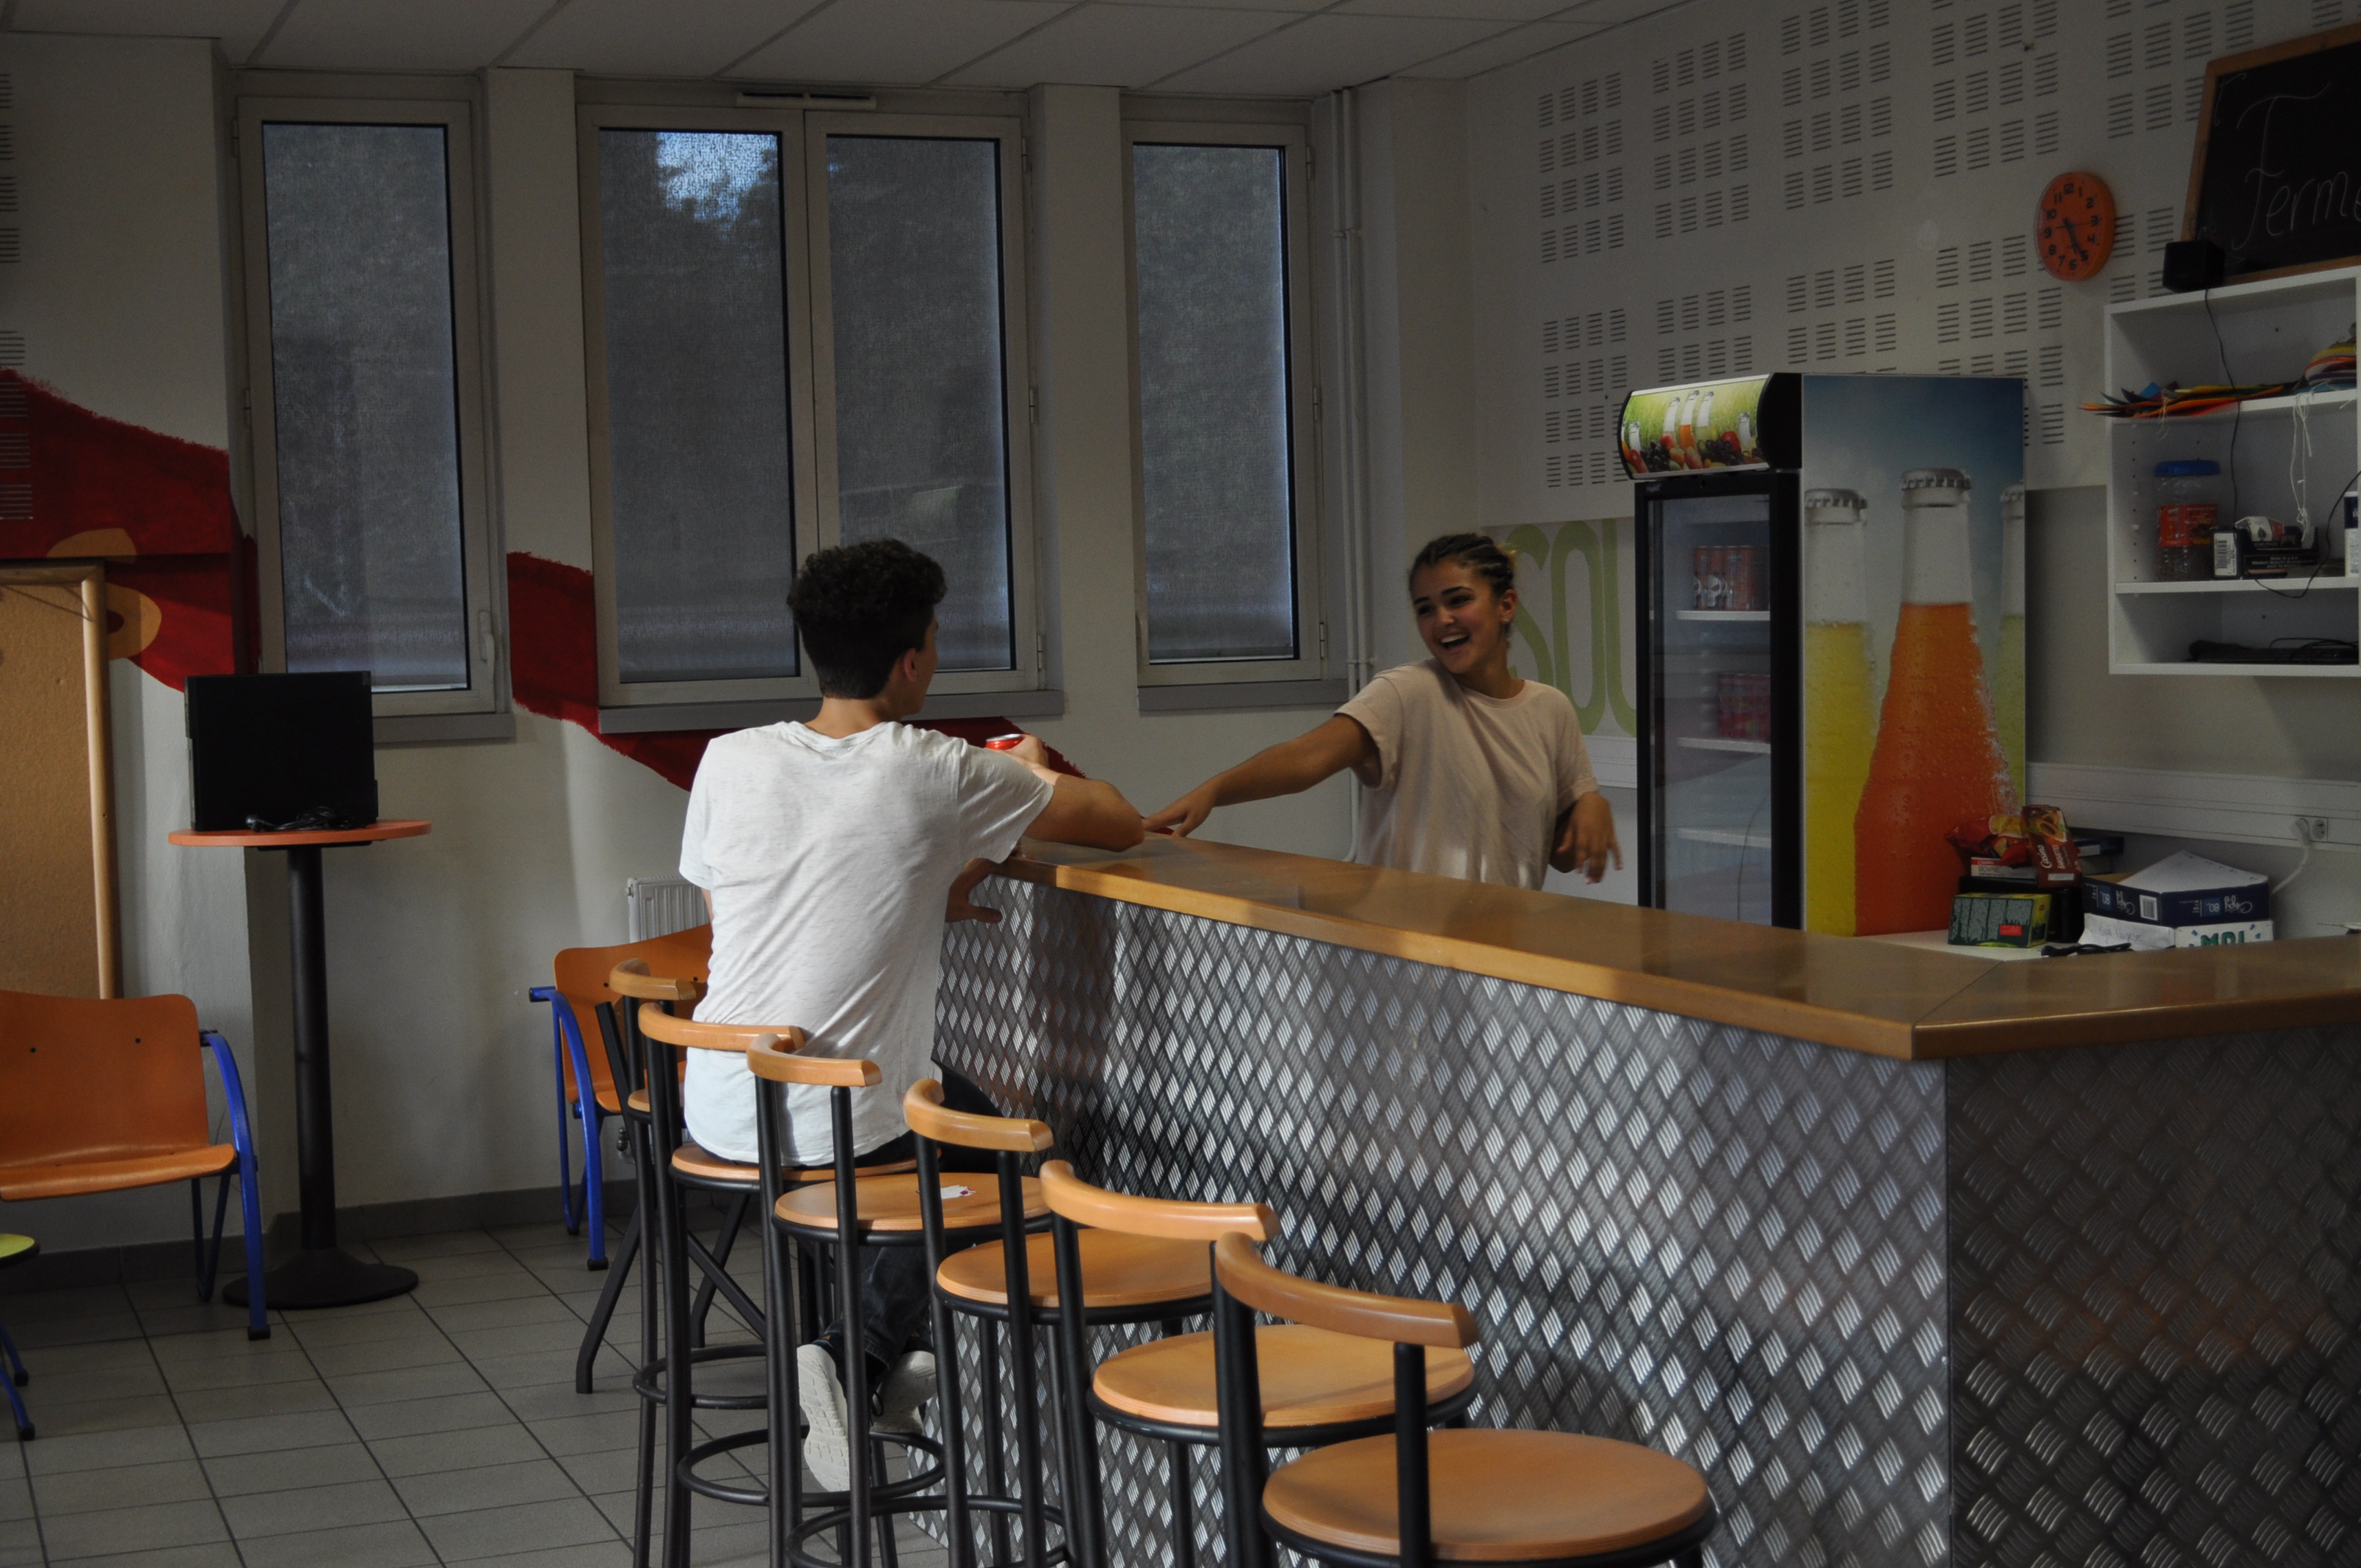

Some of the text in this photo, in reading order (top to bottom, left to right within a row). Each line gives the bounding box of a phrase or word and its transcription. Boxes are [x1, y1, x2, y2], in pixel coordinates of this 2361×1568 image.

[2064, 183, 2074, 194] 12
[2078, 186, 2083, 197] 1
[2054, 192, 2062, 204] 11
[2086, 197, 2094, 209] 2
[2047, 209, 2056, 219] 10
[2091, 215, 2099, 227] 3
[2044, 227, 2052, 238] 9
[2087, 233, 2095, 244] 4
[2048, 244, 2056, 255] 8
[2059, 254, 2066, 266] 7
[2069, 259, 2077, 270] 6
[2037, 844, 2052, 869] Casino
[2102, 893, 2111, 905] 80
[2224, 894, 2253, 914] Copy
[2209, 902, 2221, 912] 80
